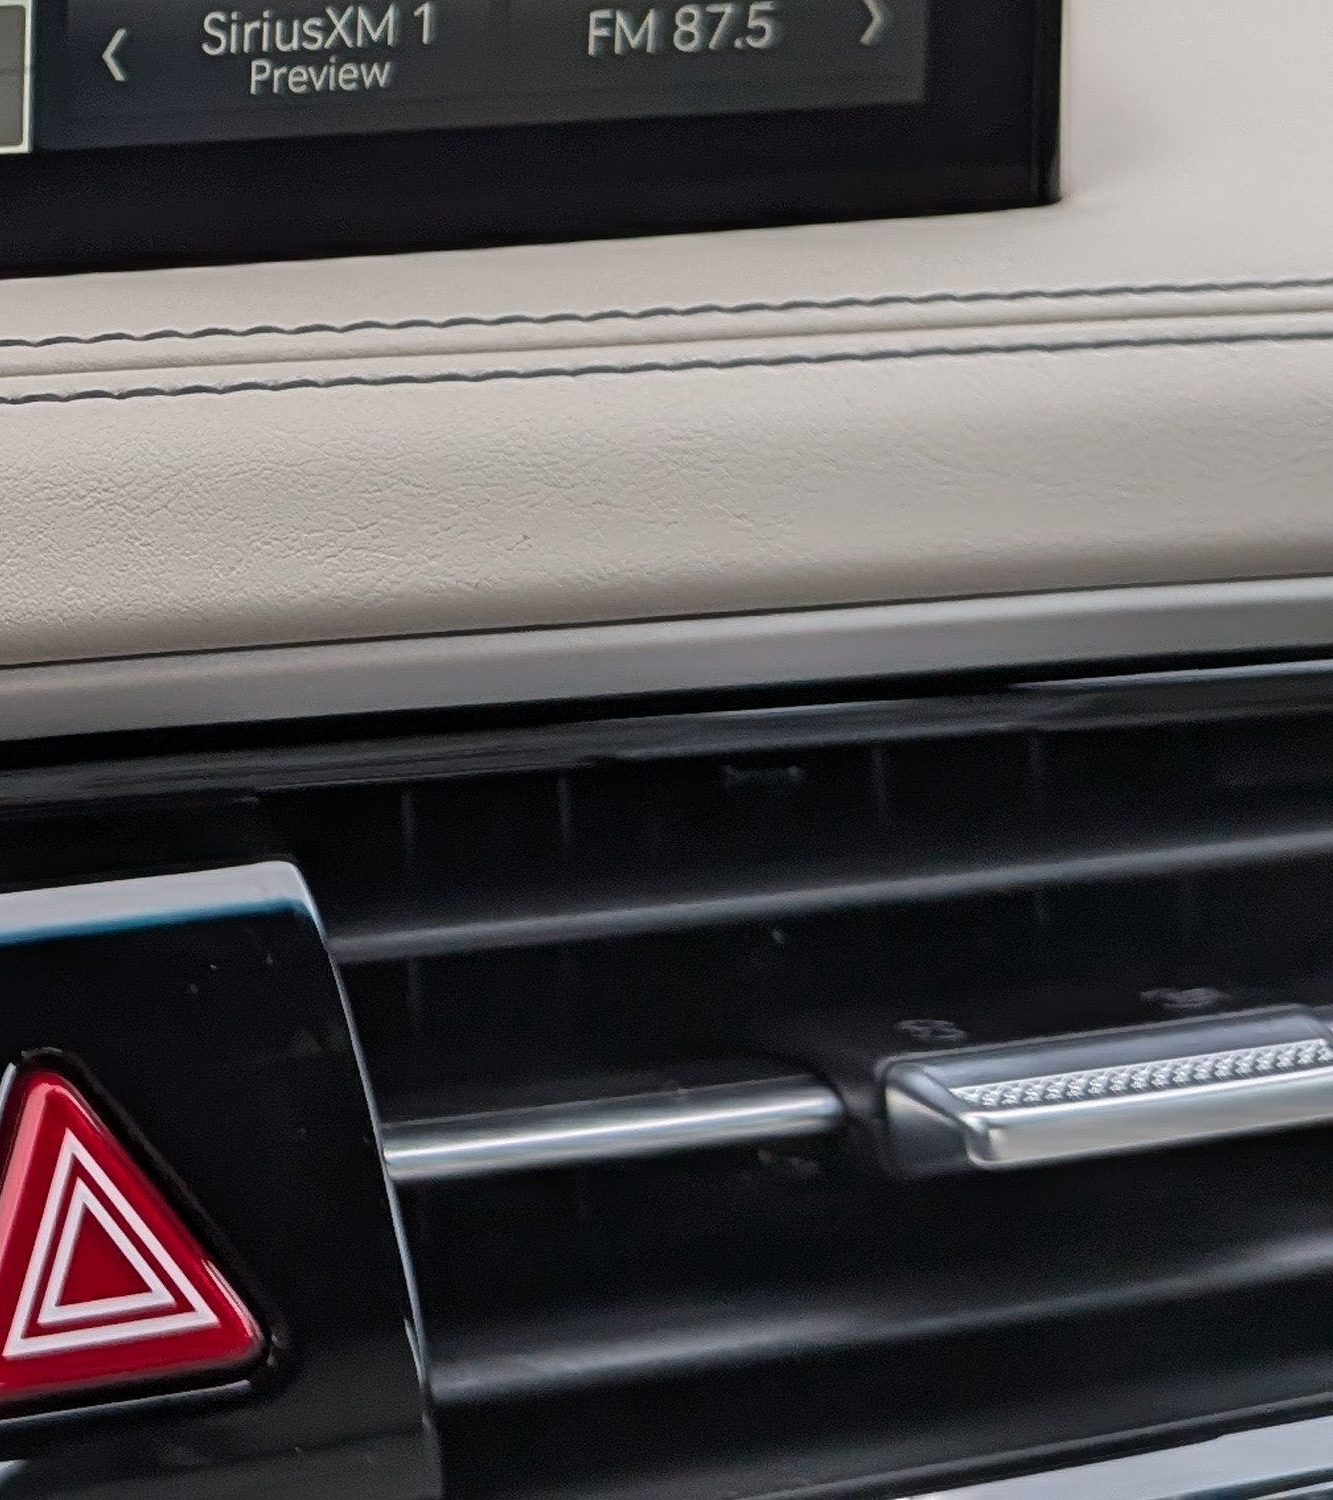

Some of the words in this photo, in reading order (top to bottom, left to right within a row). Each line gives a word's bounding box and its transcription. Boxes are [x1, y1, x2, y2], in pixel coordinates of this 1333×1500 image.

[200, 5, 397, 56] SiriusXM
[412, 2, 438, 44] 1
[587, 8, 659, 56] FM
[671, 1, 779, 52] 87.5
[249, 56, 393, 95] Preview
